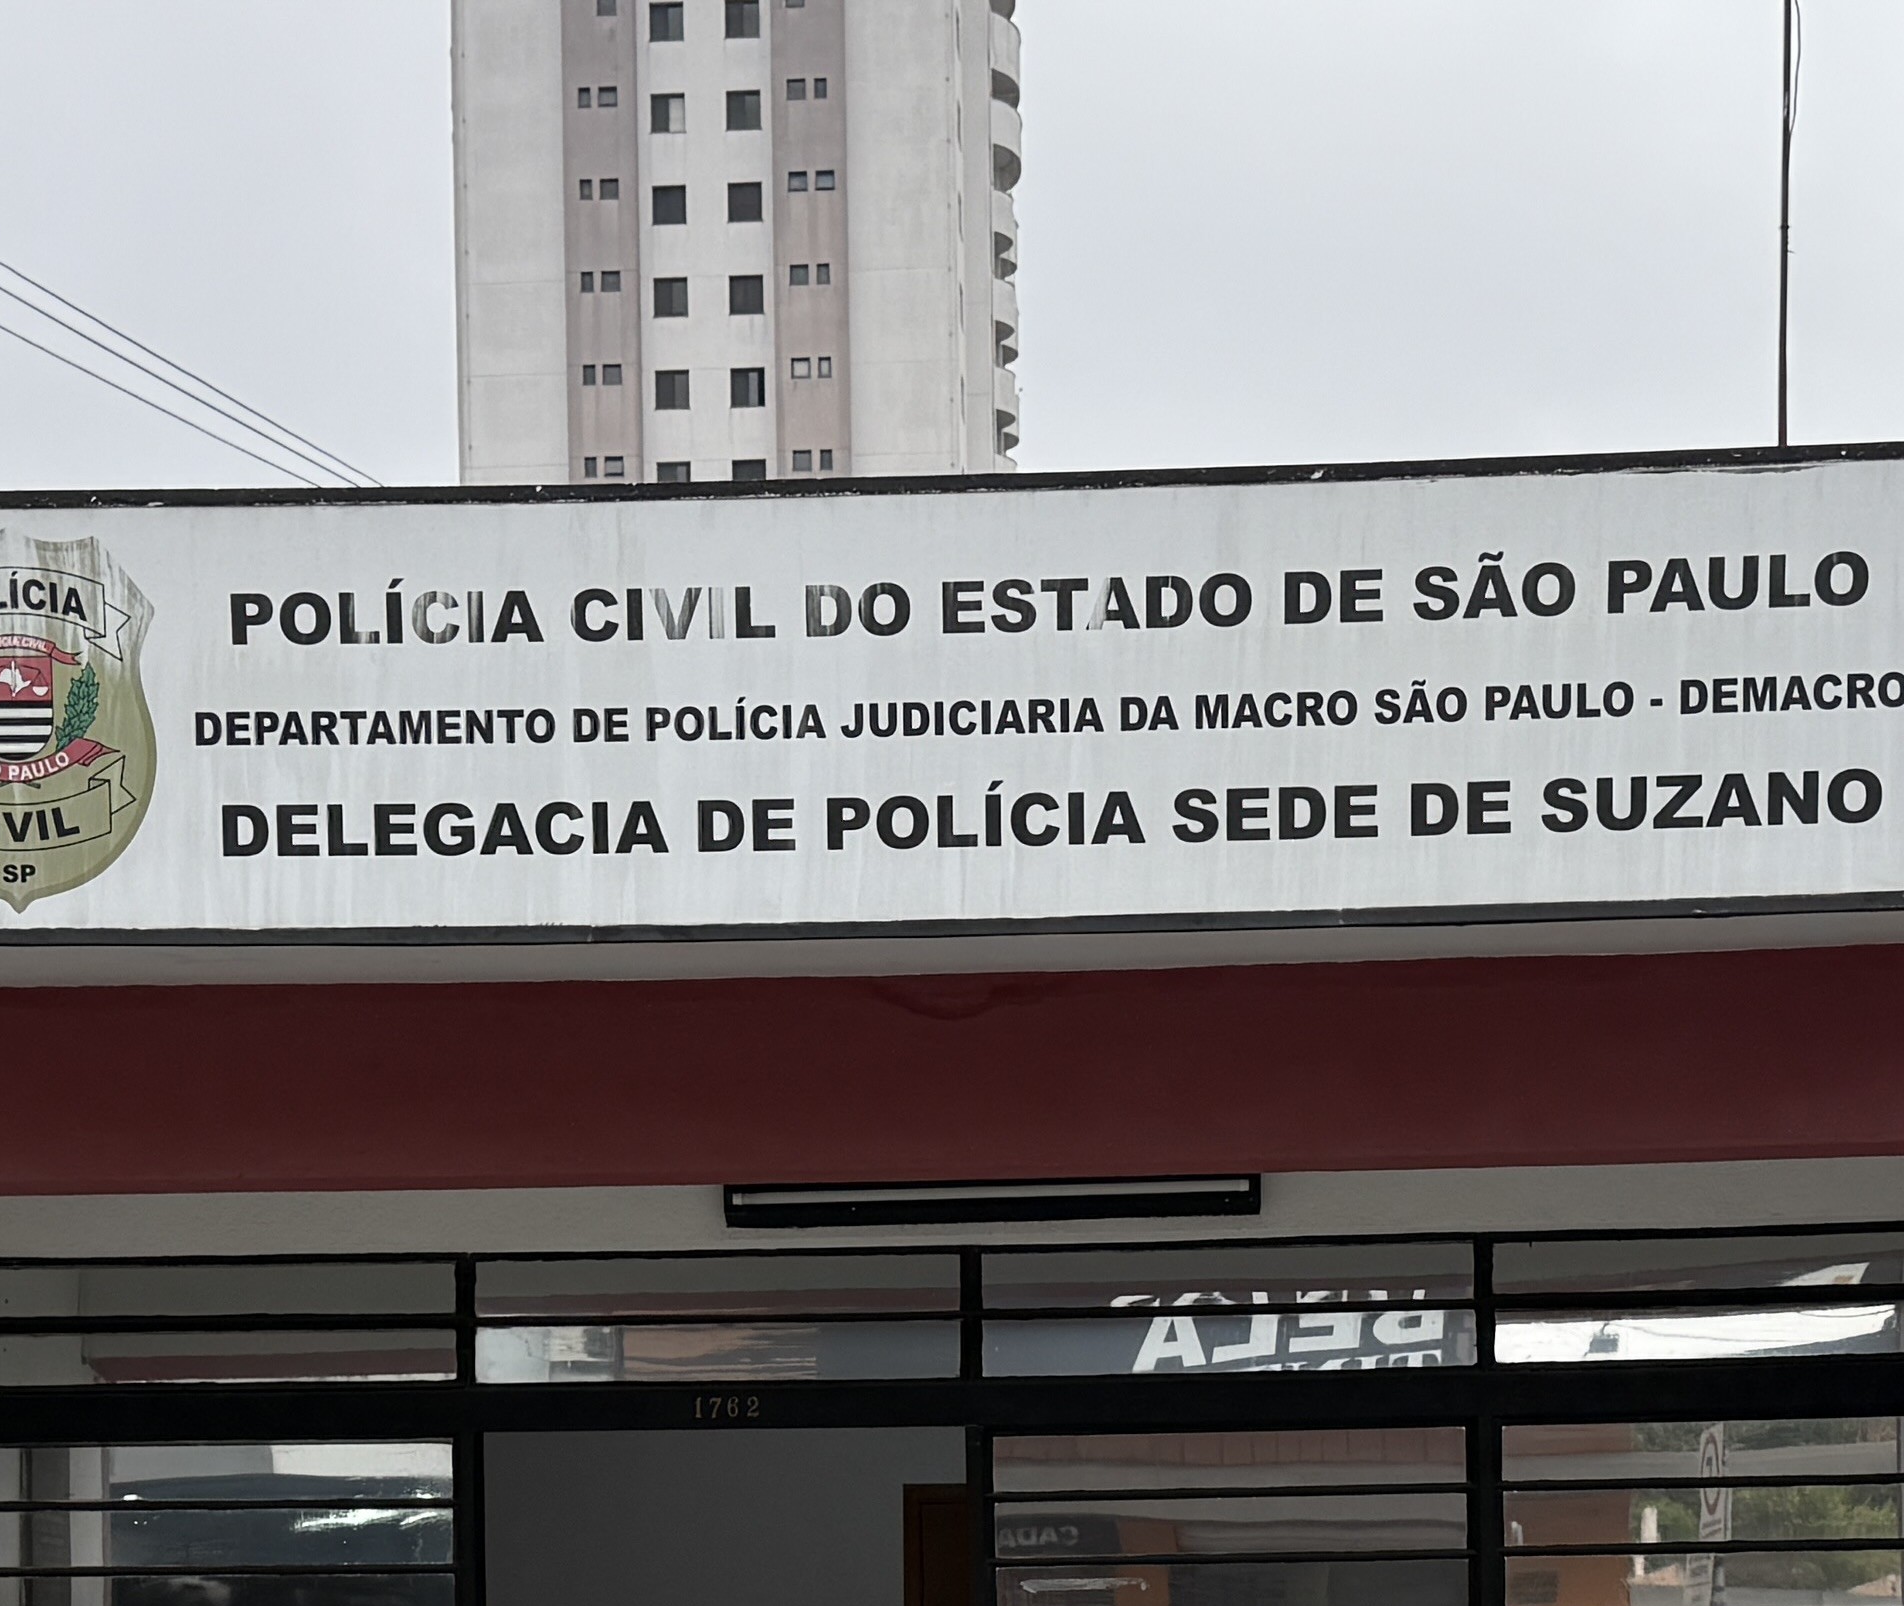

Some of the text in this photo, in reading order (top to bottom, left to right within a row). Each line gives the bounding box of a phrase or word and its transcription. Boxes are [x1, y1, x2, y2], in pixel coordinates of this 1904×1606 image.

[229, 551, 1870, 645] POLÍCIA CIVIL DO ESTADO DE SÃO PAULO
[195, 708, 556, 746] DEPARTAMENTO
[572, 707, 630, 743] DE
[645, 696, 827, 743] POLÍCIA
[840, 698, 1105, 739] JUDICIARIA
[1120, 695, 1180, 732] DA
[1195, 689, 1358, 730] MACRO
[1373, 679, 1468, 725] SÃO
[1484, 681, 1634, 721] PAULO
[8, 751, 70, 781] PAULO
[221, 768, 1883, 857] DELEGACIA DE POLÍCIA SEDE DE SUZANO
[2, 864, 37, 884] SP
[694, 1396, 760, 1419] 1762
